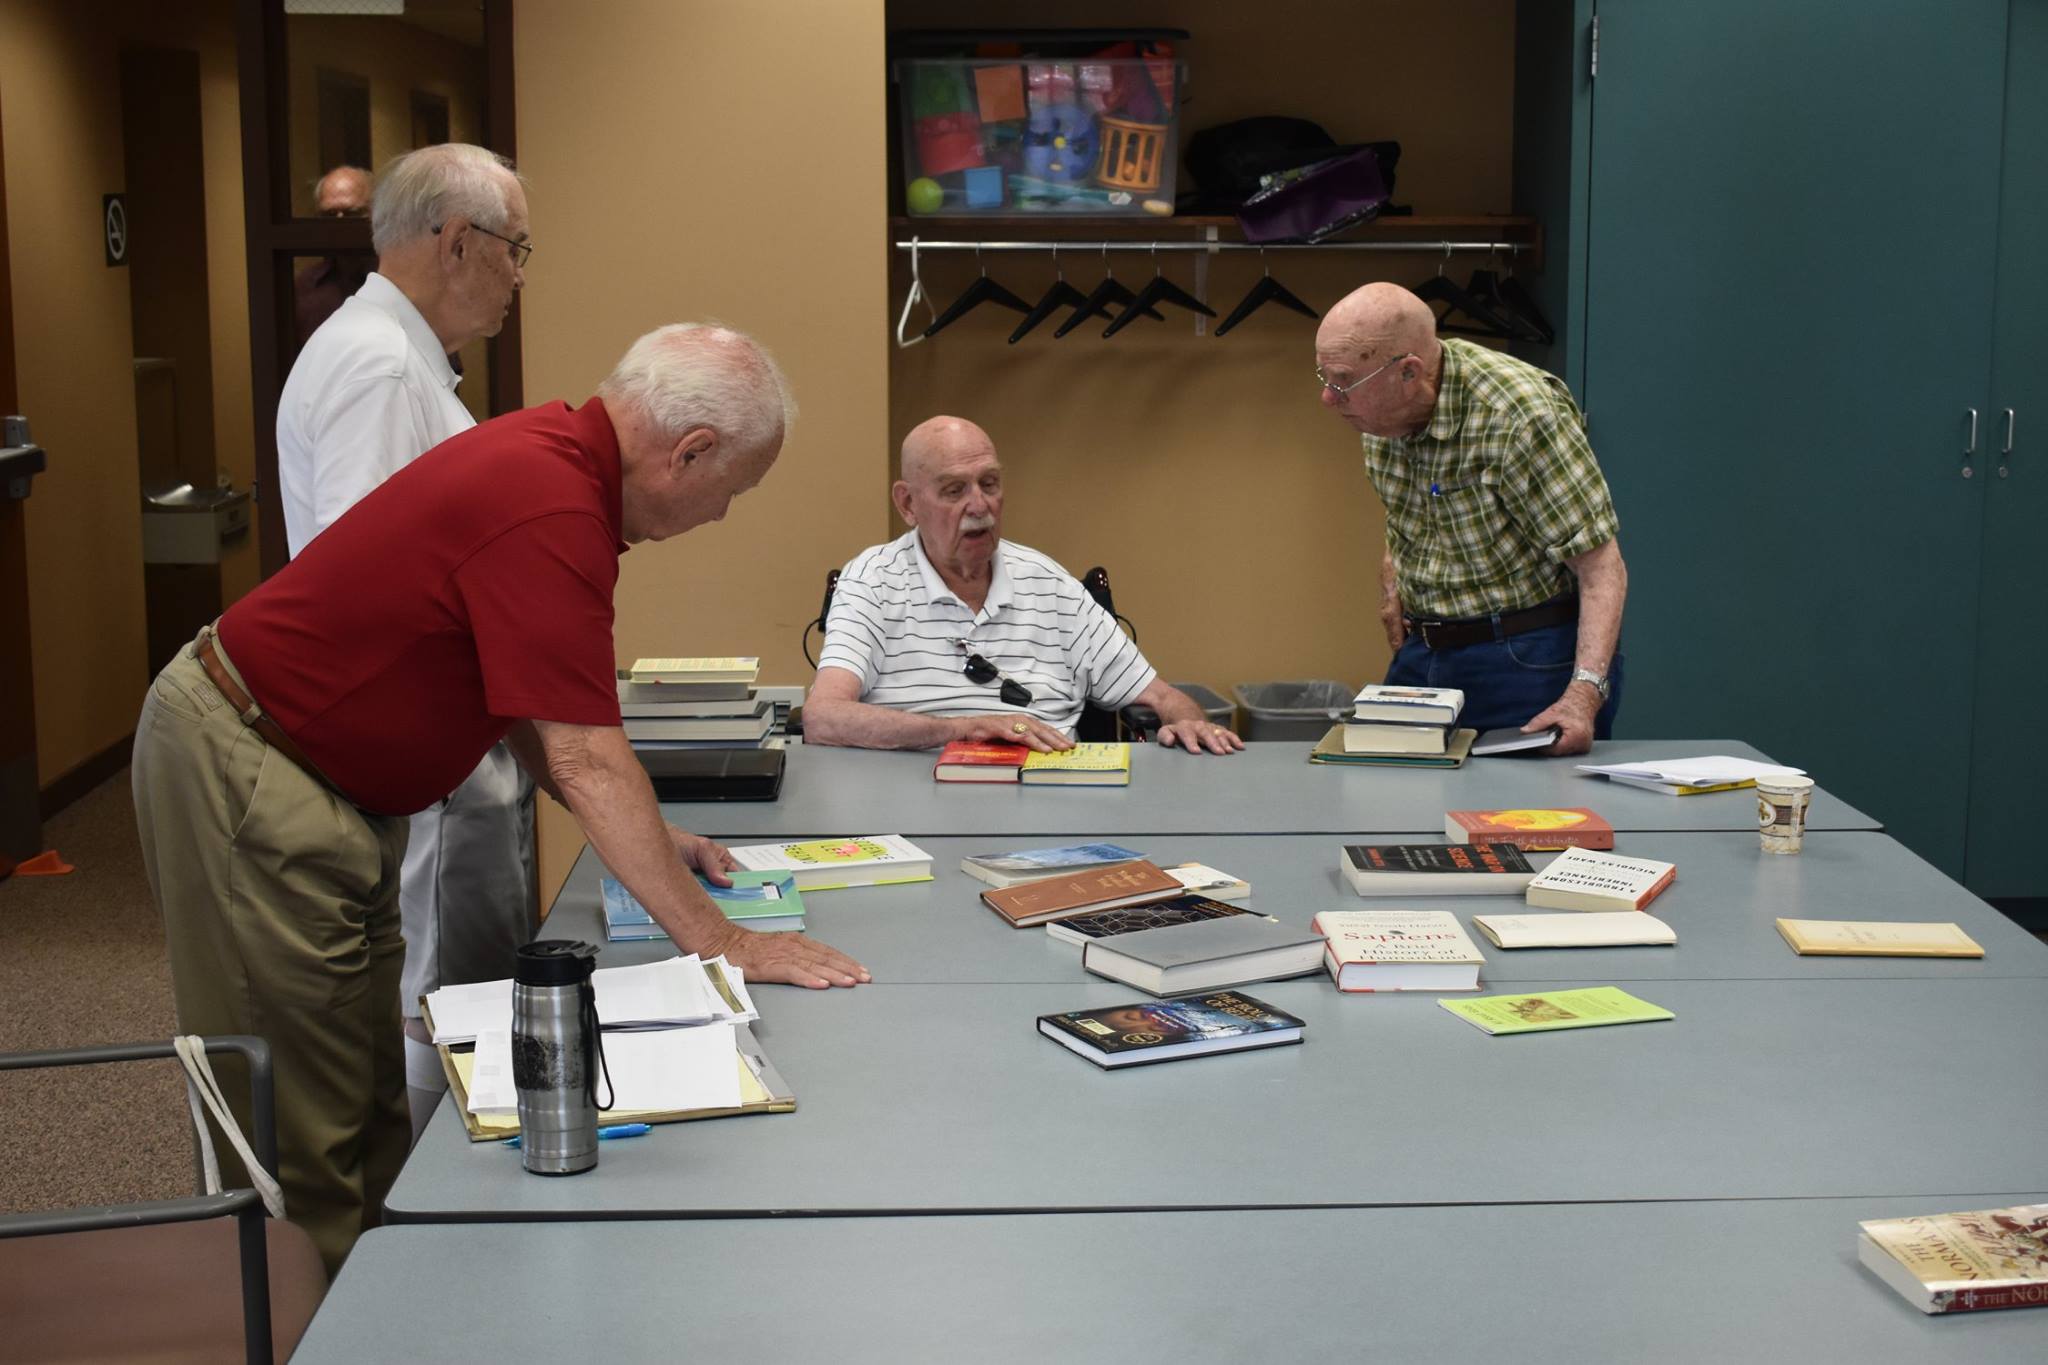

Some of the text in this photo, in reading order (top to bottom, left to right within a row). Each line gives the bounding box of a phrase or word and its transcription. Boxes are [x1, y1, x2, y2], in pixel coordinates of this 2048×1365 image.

[1567, 855, 1597, 864] WADE
[1601, 861, 1657, 875] NICHOLAS
[1543, 875, 1625, 892] TROUBLESOME
[1558, 870, 1634, 887] INHERITANCE
[1343, 931, 1457, 943] Sapiens
[1206, 999, 1229, 1009] OF
[1902, 1217, 1979, 1281] NORMANS
[1905, 1243, 1935, 1262] THE
[1983, 1293, 2010, 1305] THE
